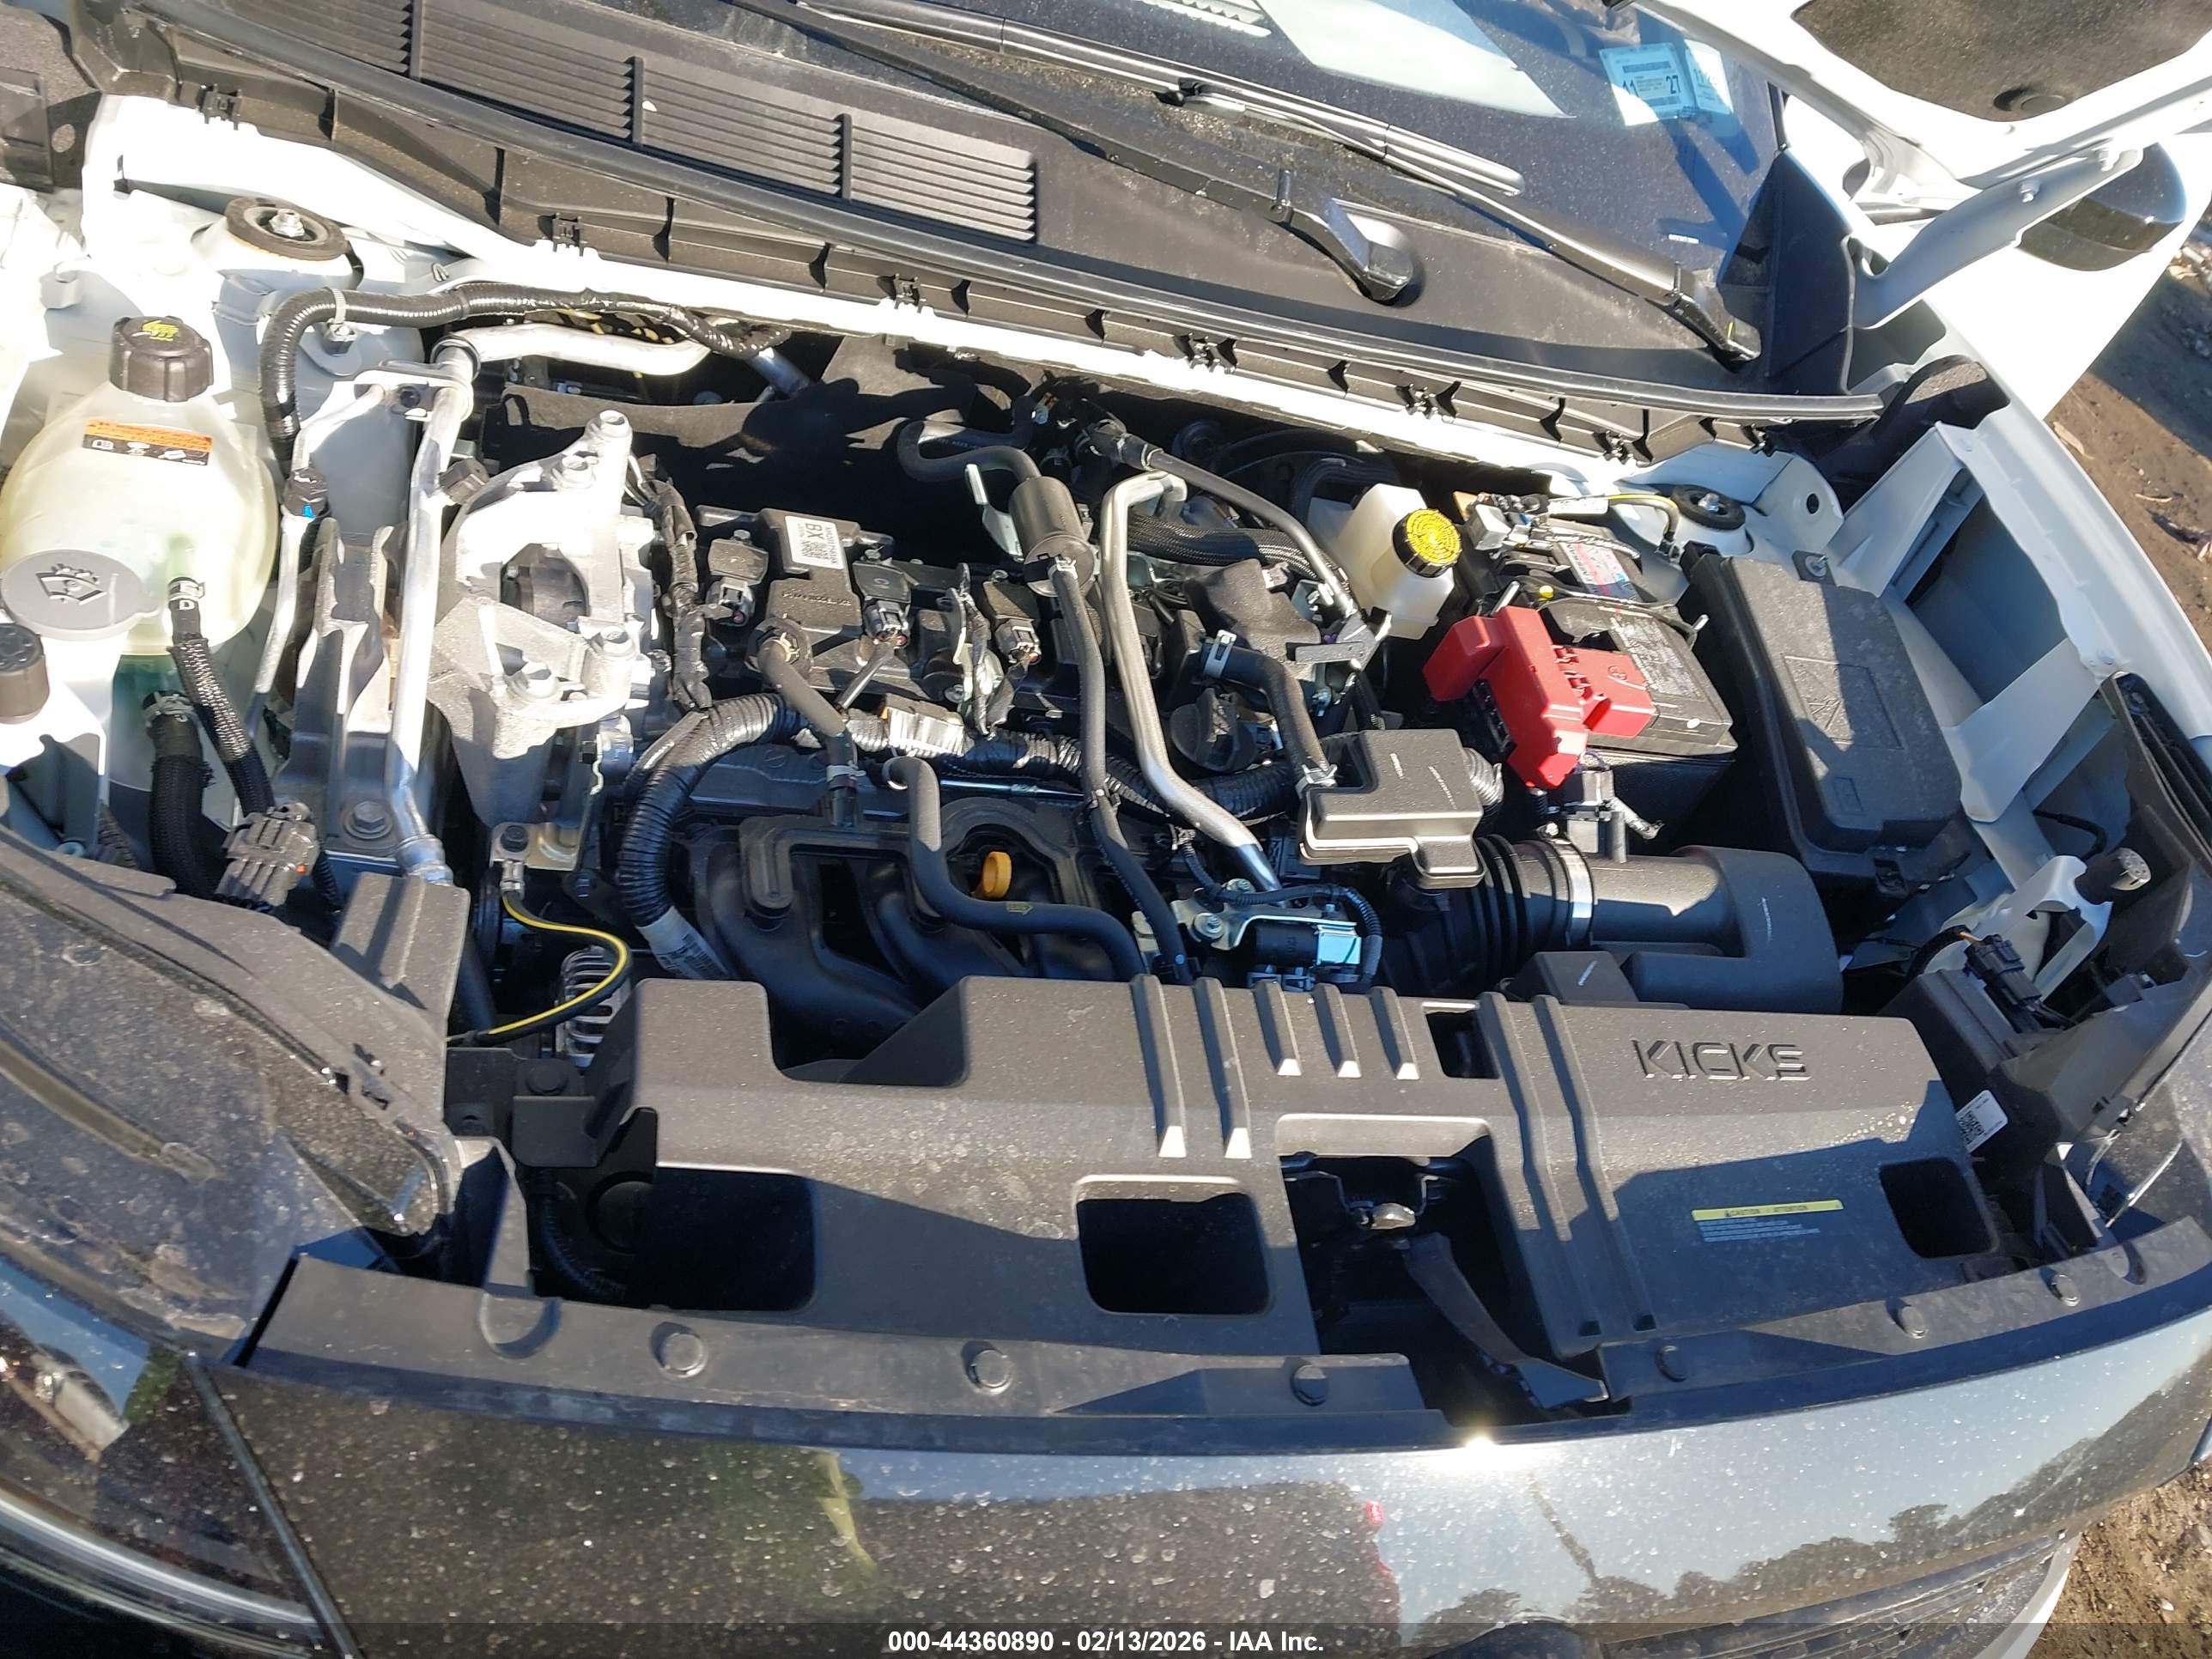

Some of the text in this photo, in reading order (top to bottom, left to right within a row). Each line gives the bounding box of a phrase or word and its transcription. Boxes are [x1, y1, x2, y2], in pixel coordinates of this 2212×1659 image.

[1666, 75, 1681, 94] 27
[805, 522, 824, 542] BX
[1632, 1040, 1811, 1080] KICKS
